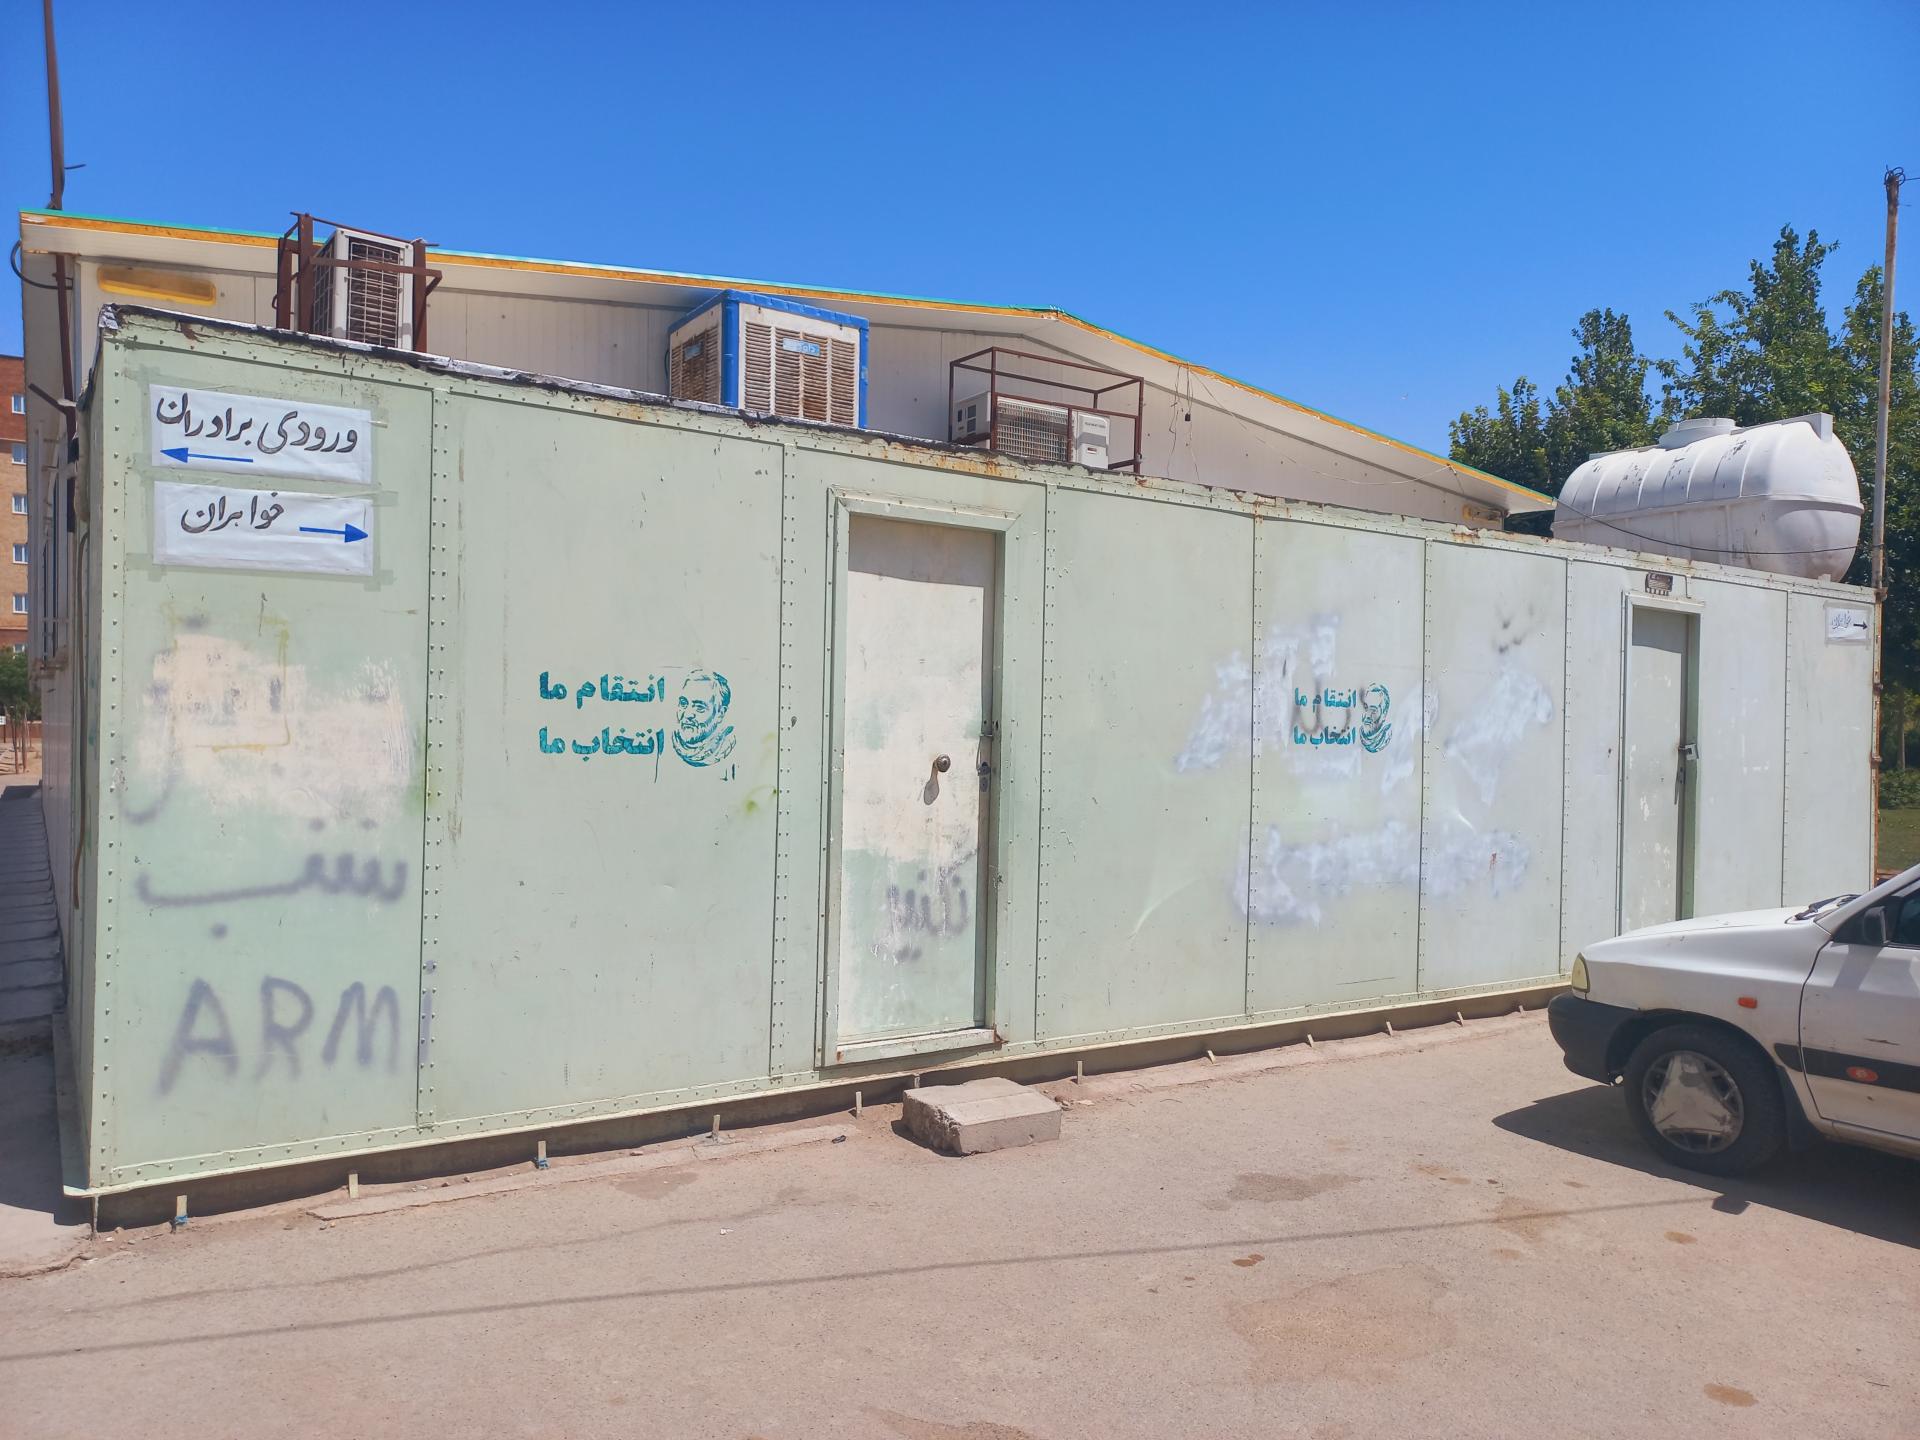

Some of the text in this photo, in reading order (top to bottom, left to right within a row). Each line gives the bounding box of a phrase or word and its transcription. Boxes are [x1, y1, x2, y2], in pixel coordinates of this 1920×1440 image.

[156, 392, 358, 454] ورودی برادران
[181, 491, 285, 533] خواهران
[539, 671, 665, 710] انتقام ما
[1294, 687, 1357, 713] انتقام ما
[538, 725, 665, 762] انتخاب ما
[1293, 725, 1357, 750] انتخاب ما
